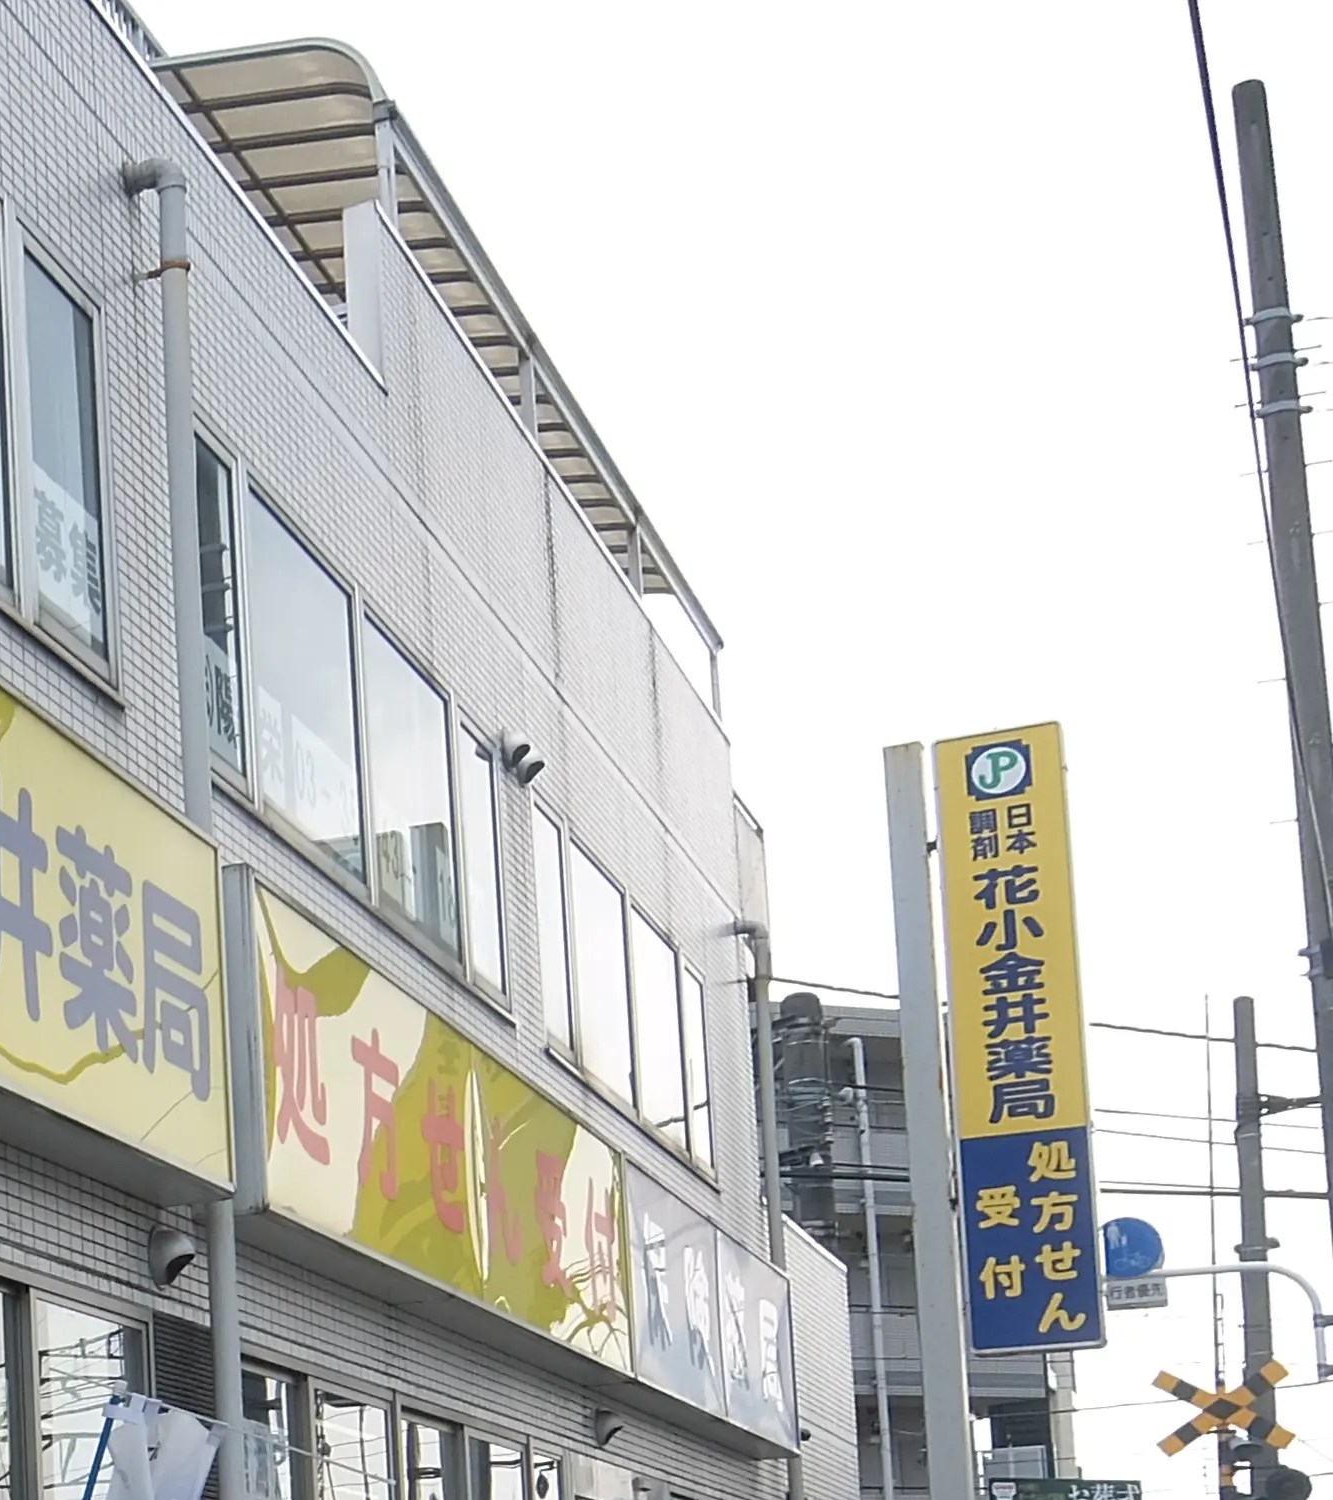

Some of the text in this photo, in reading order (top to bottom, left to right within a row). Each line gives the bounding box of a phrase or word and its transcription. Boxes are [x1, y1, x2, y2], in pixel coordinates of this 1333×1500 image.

[969, 809, 999, 861] 調剤
[1006, 804, 1037, 855] 日本
[972, 865, 1056, 1126] 花小金井薬局
[976, 1185, 1025, 1301] 受付
[1028, 1140, 1086, 1333] 処方せん
